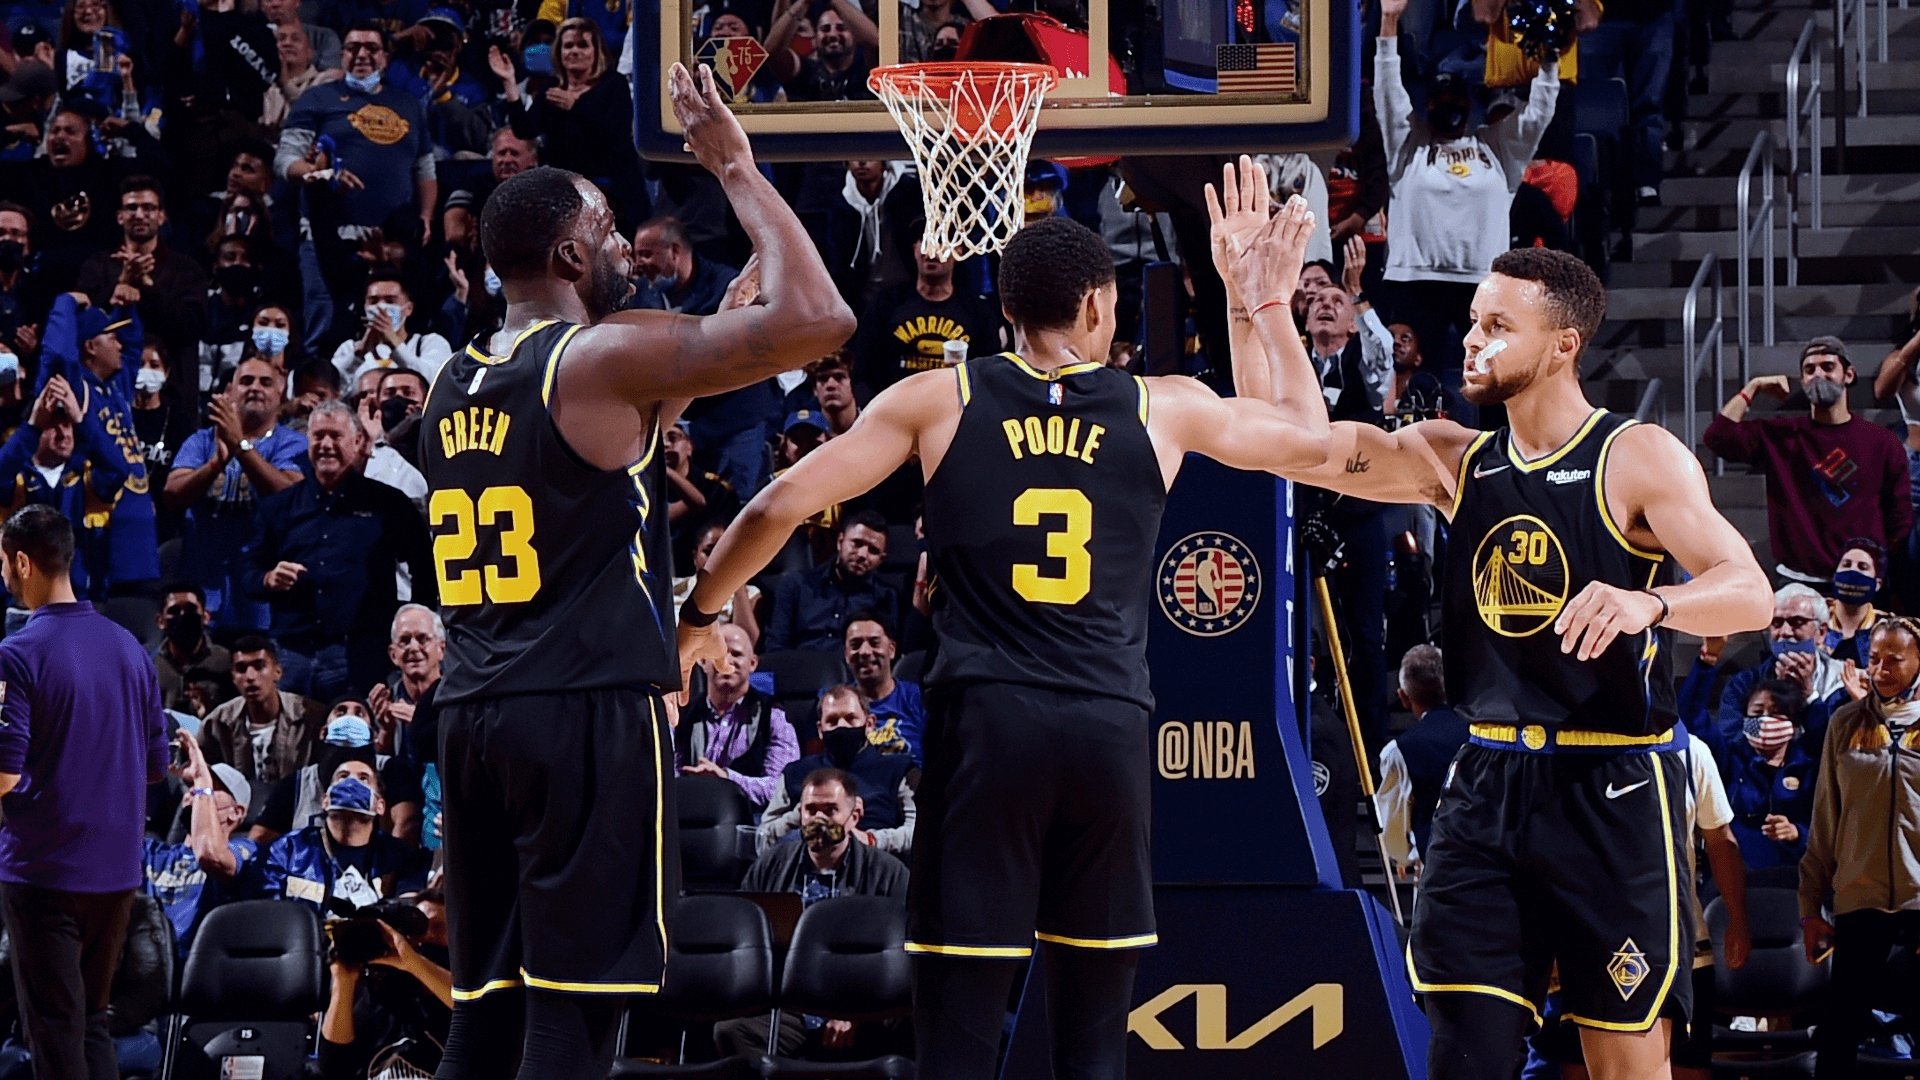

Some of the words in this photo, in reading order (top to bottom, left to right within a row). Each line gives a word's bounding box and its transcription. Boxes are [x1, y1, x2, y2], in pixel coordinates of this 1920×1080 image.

[738, 46, 752, 65] 75
[439, 407, 511, 459] GREEN
[1002, 416, 1106, 464] POOLE
[1546, 469, 1591, 482] Rakuten
[429, 485, 541, 606] 23
[1012, 488, 1092, 604] 3
[1508, 530, 1547, 565] 30
[1157, 721, 1255, 779] @NBA
